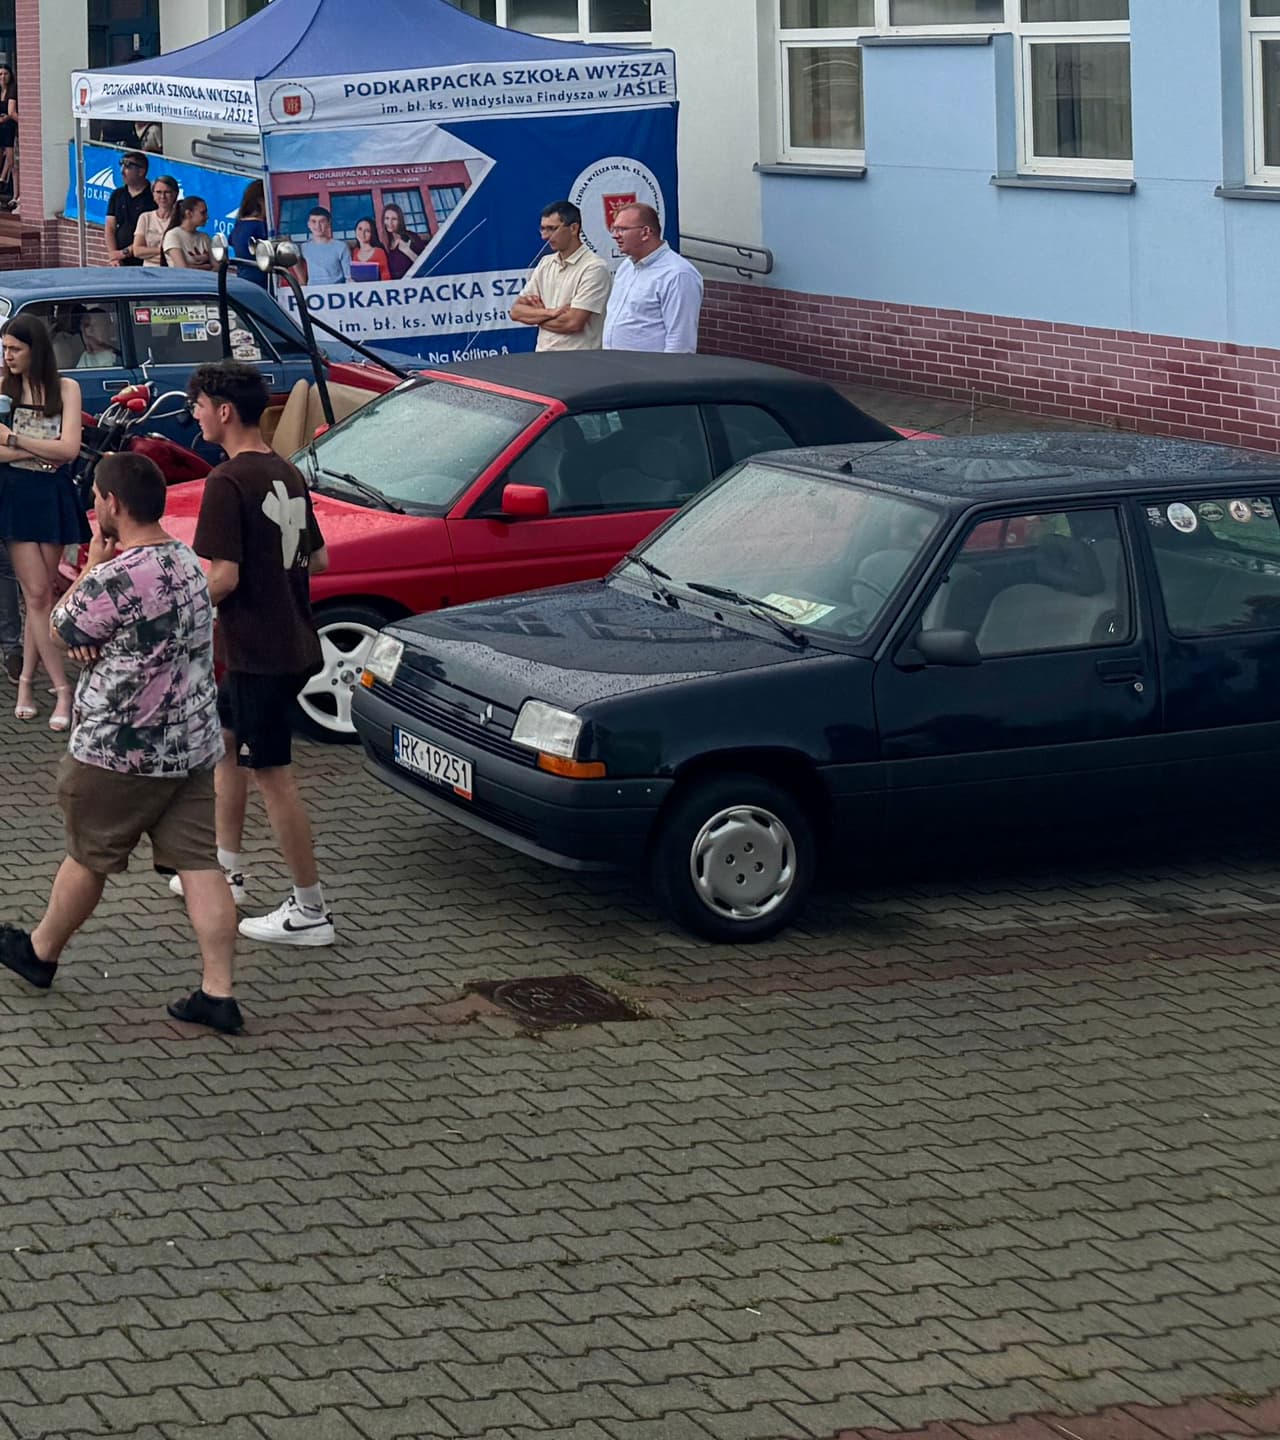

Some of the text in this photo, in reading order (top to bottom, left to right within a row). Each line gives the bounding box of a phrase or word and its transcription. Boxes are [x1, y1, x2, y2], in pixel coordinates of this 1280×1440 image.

[102, 82, 166, 96] PODKARPACKA
[167, 83, 206, 100] SZKOŁA
[343, 61, 667, 97] PODKARPACKA SZKOŁA WYŻSZA
[382, 78, 667, 115] im. bł. ks. Władysława Findysza w JAŚLE
[223, 103, 253, 123] JAŚLE
[288, 281, 484, 311] PODKARPACKA
[339, 320, 367, 333] im.
[373, 317, 396, 331] bł.
[402, 314, 426, 329] ks.
[428, 352, 449, 363] Na
[401, 734, 420, 766] RK
[426, 746, 468, 790] 19251
